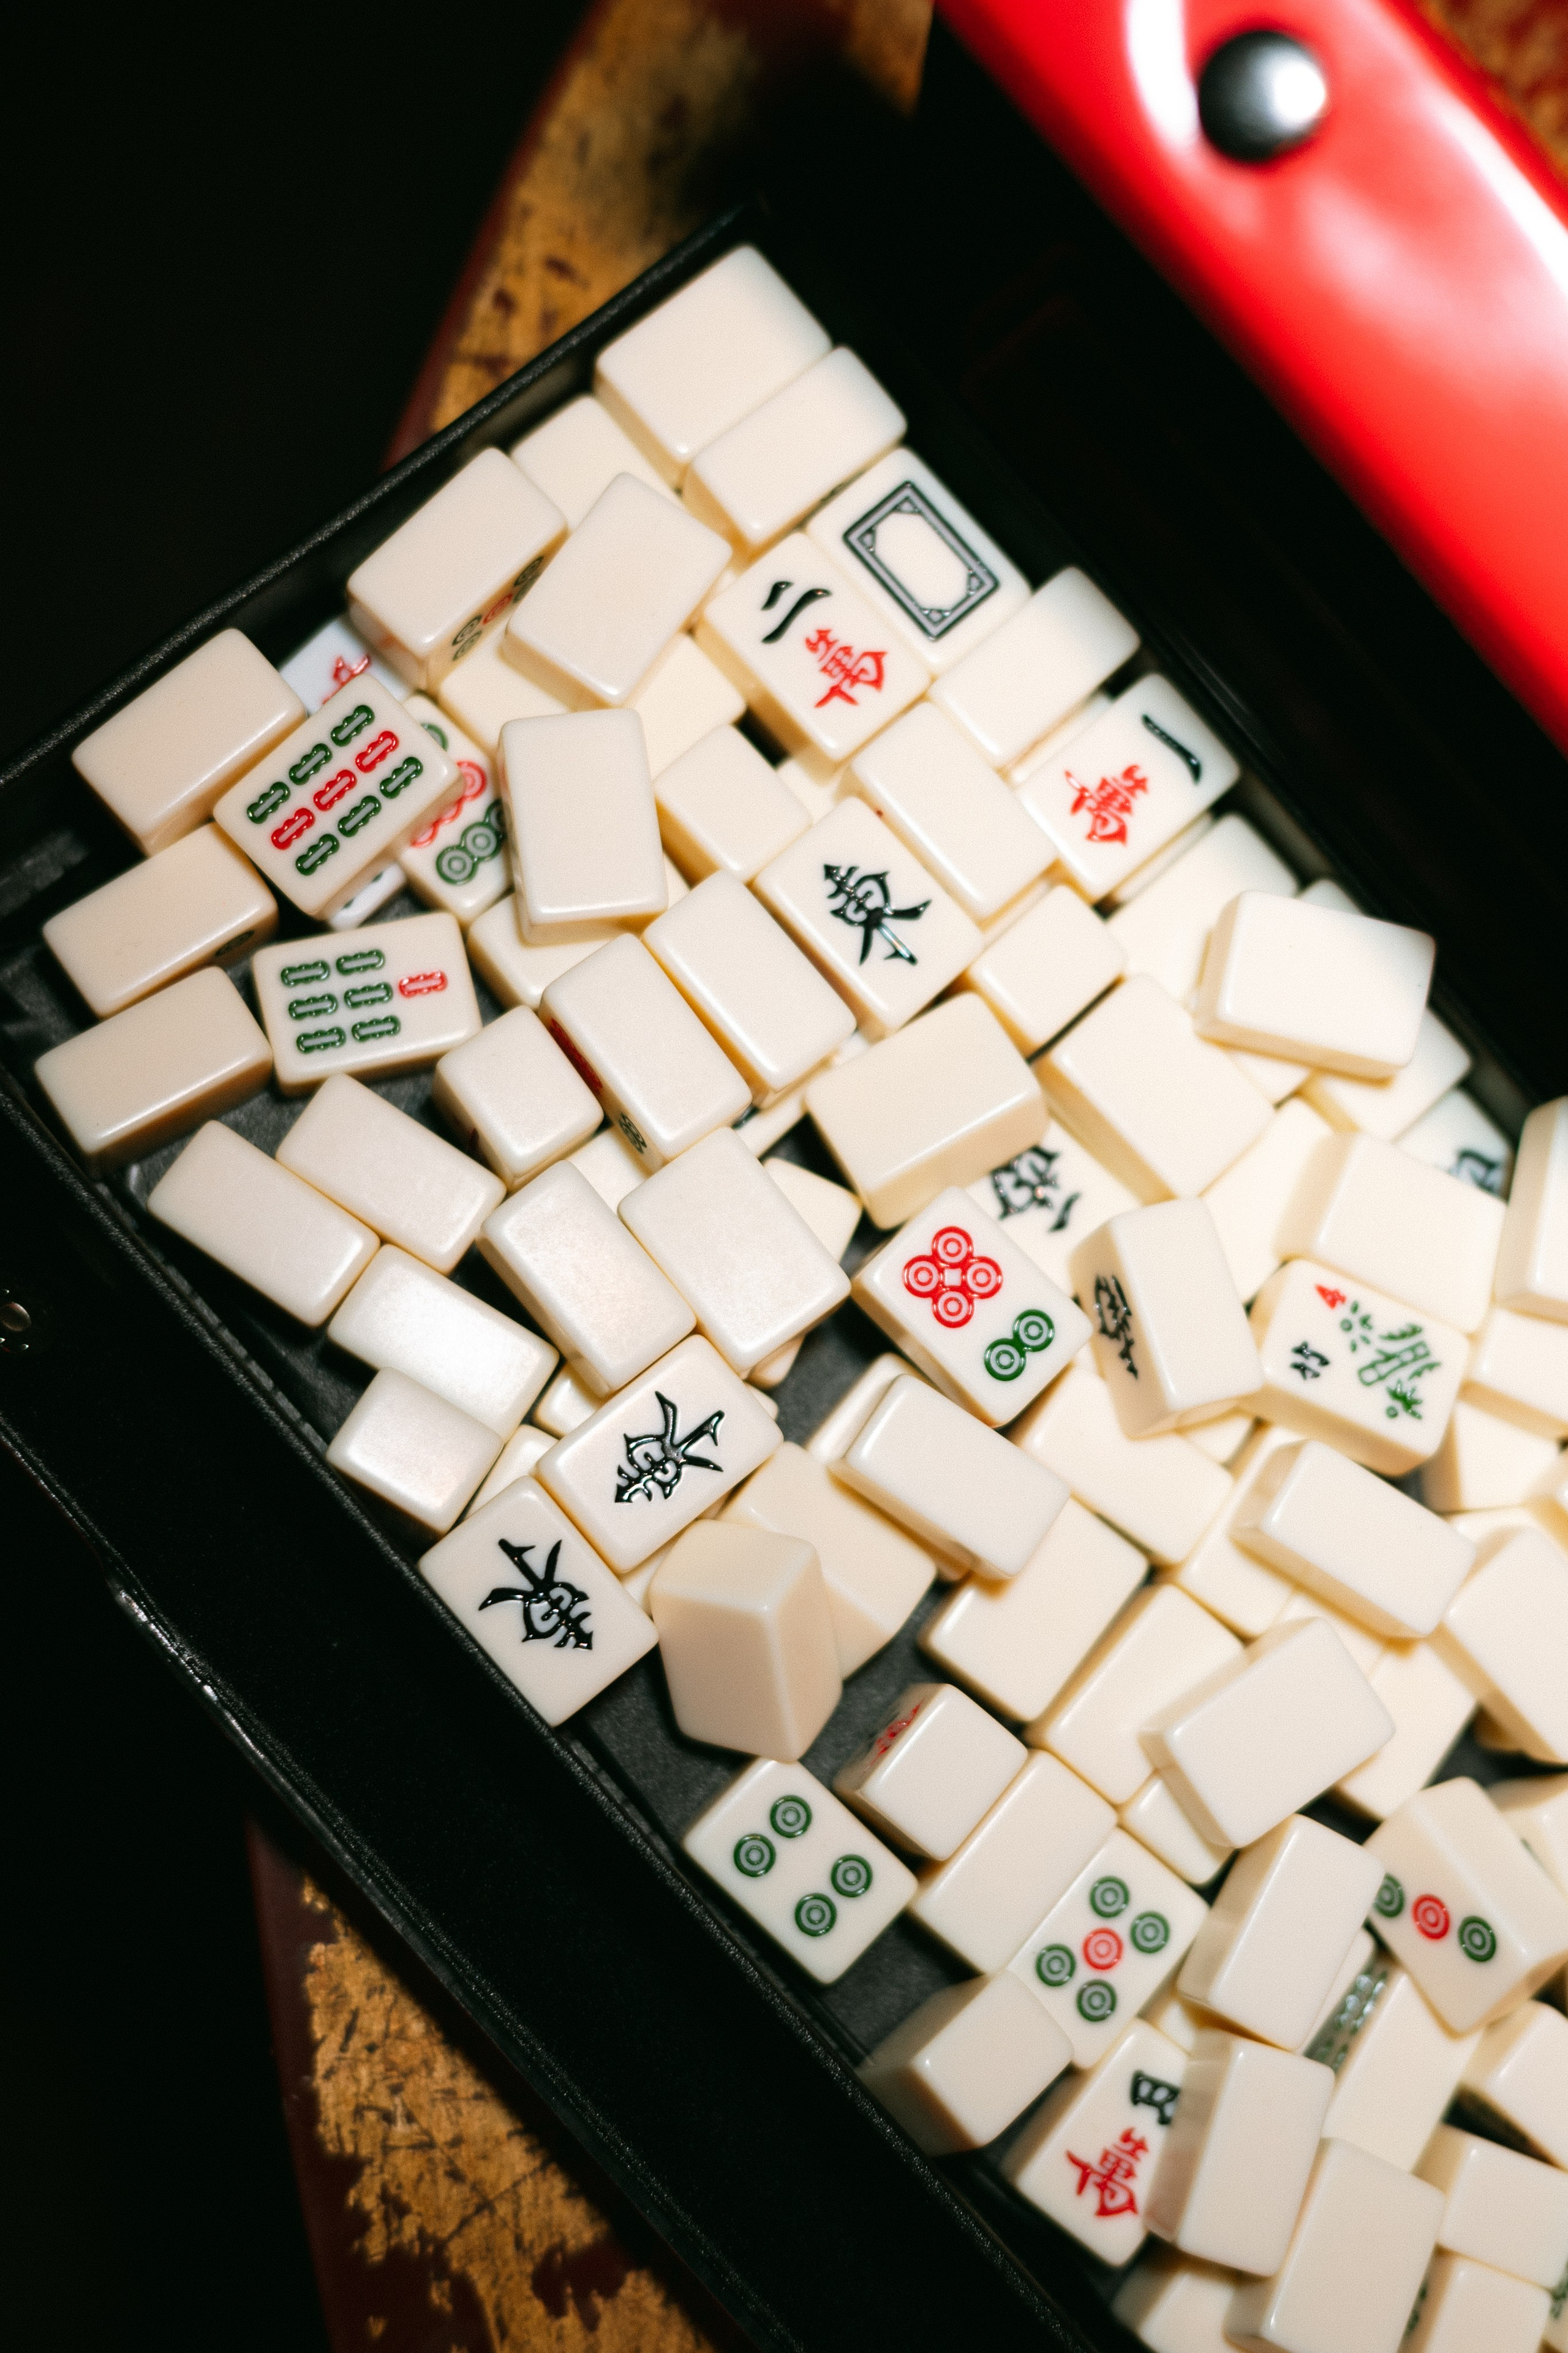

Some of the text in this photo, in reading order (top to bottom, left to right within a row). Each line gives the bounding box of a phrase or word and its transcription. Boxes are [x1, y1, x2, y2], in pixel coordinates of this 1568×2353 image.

[761, 581, 888, 708] 二萬
[1065, 714, 1202, 846] 一萬
[823, 863, 932, 966] 東
[614, 1390, 725, 1504] 東
[478, 1538, 594, 1651] 東
